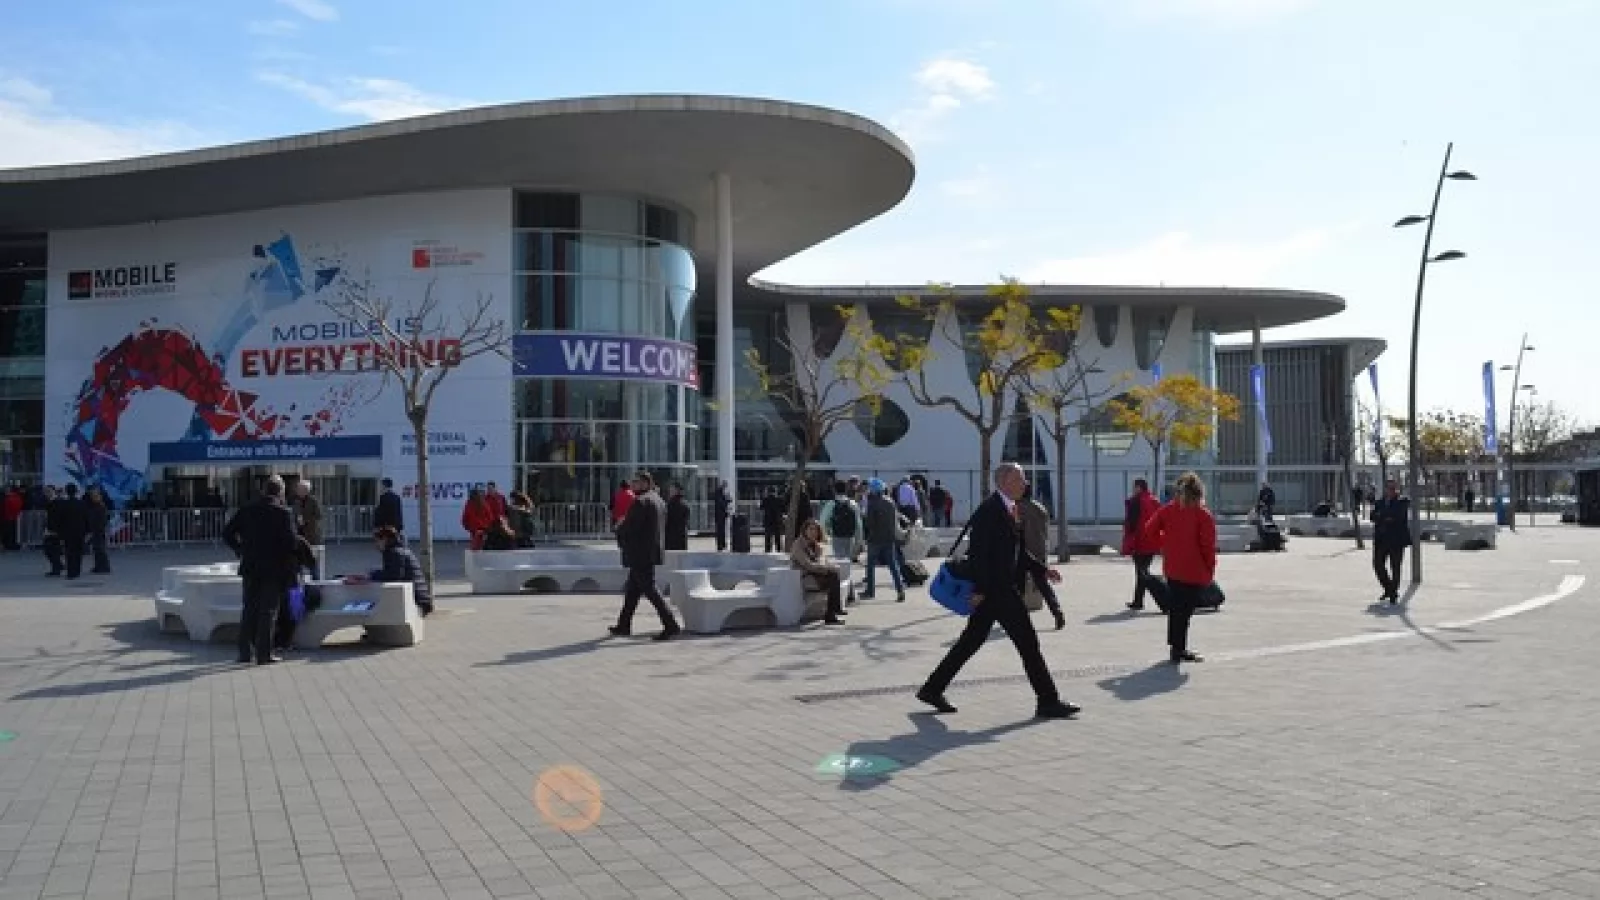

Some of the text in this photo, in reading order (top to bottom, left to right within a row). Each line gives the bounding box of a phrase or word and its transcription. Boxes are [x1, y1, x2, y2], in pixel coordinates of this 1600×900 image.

[94, 262, 176, 289] MOBILE
[272, 316, 423, 341] MOBILE IS
[241, 339, 461, 378] EVERYTHING
[401, 432, 466, 443] MINTERIAL
[206, 442, 316, 458] Entrance with Badge
[401, 445, 466, 455] PRRAMME
